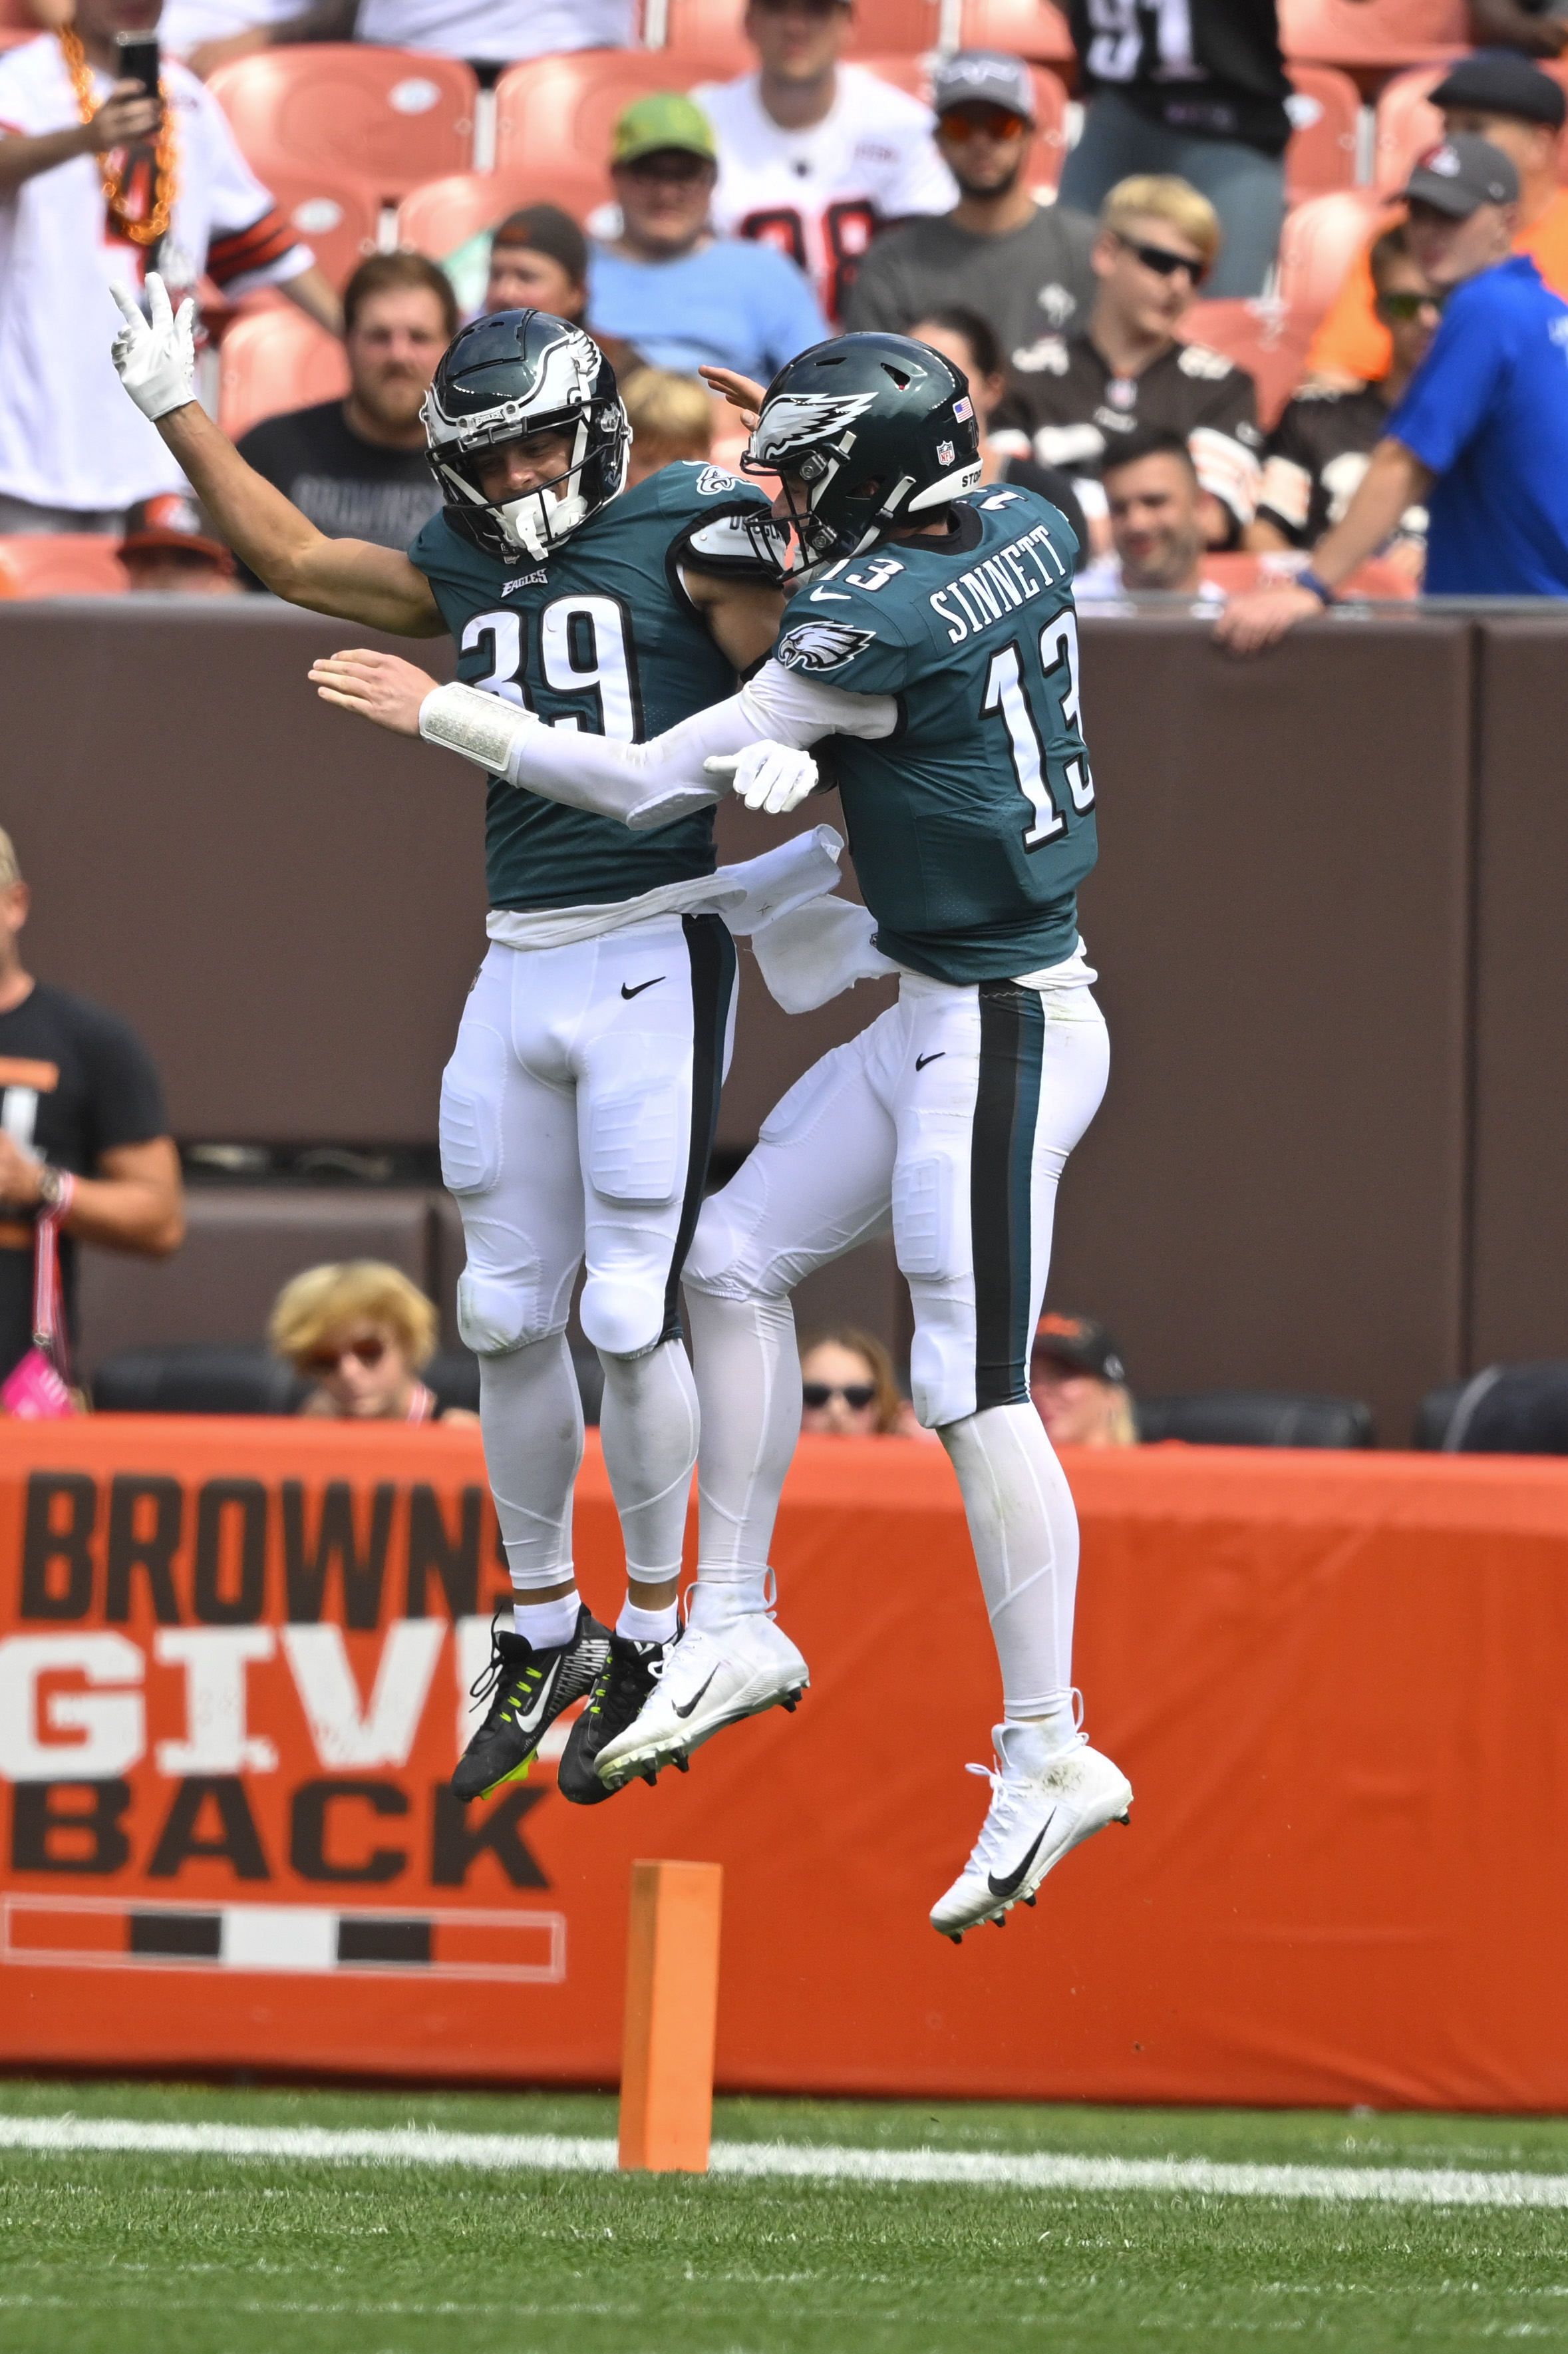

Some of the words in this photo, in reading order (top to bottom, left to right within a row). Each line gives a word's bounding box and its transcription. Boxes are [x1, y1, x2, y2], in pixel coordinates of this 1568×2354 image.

[500, 568, 548, 597] EAGLES
[818, 558, 907, 593] 13
[929, 524, 1066, 644] SINNETT
[458, 591, 644, 745] 39
[979, 605, 1096, 854] 13
[11, 1776, 551, 1890] BACK
